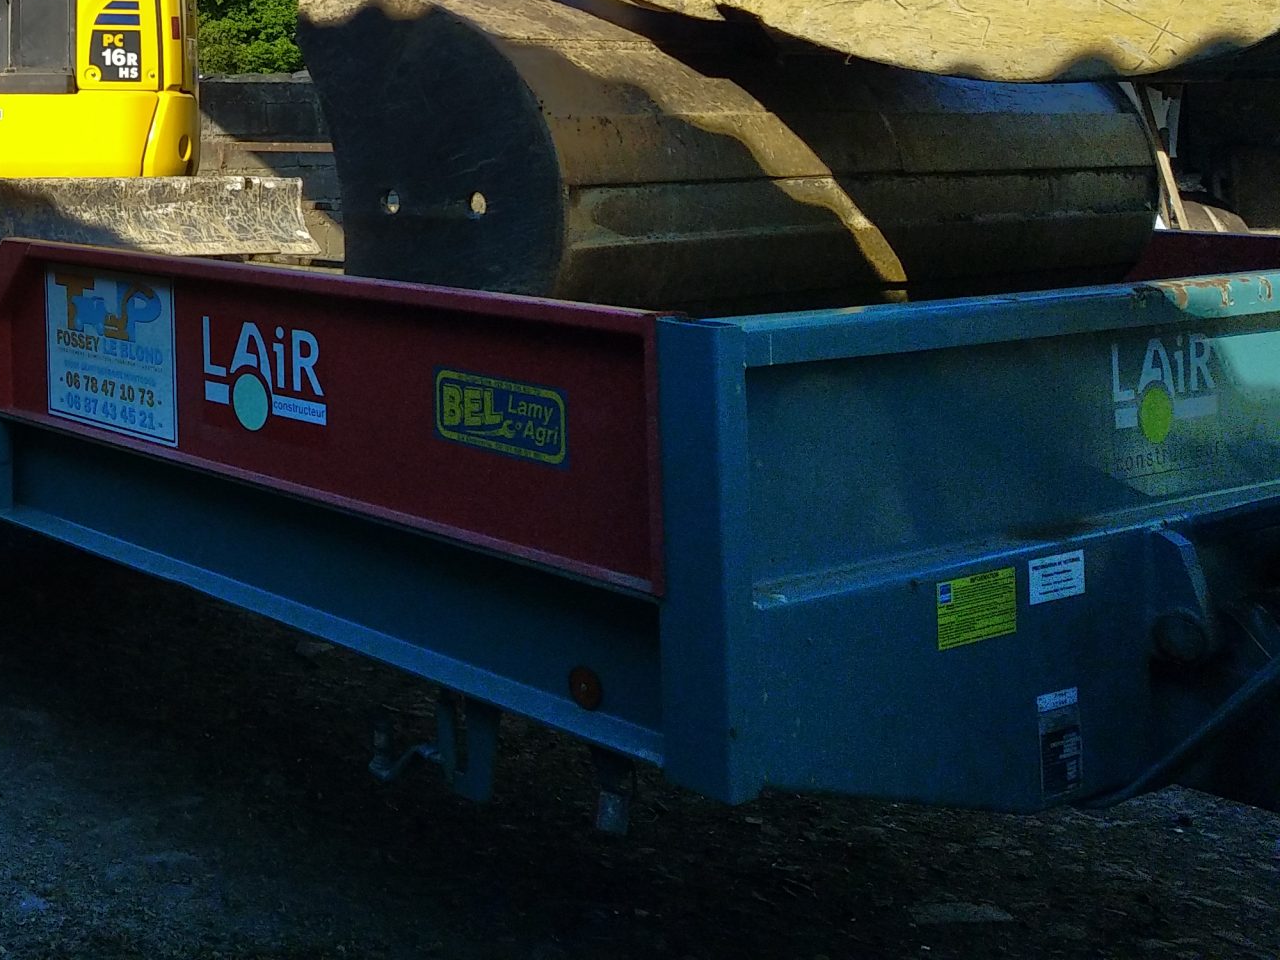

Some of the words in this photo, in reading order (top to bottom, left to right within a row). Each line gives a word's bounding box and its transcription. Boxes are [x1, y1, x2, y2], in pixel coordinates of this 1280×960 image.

[102, 33, 124, 47] PC
[101, 48, 139, 66] 16R
[118, 67, 139, 79] HS
[56, 329, 100, 353] FOSSEY
[103, 338, 118, 357] LE
[120, 342, 164, 366] BLOND
[66, 371, 80, 390] 06
[83, 374, 99, 394] 78
[101, 379, 116, 398] 47
[119, 383, 135, 403] 10
[138, 388, 155, 407] 73
[273, 400, 325, 418] constructeur
[442, 382, 504, 426] BEL
[507, 394, 554, 426] Lamy
